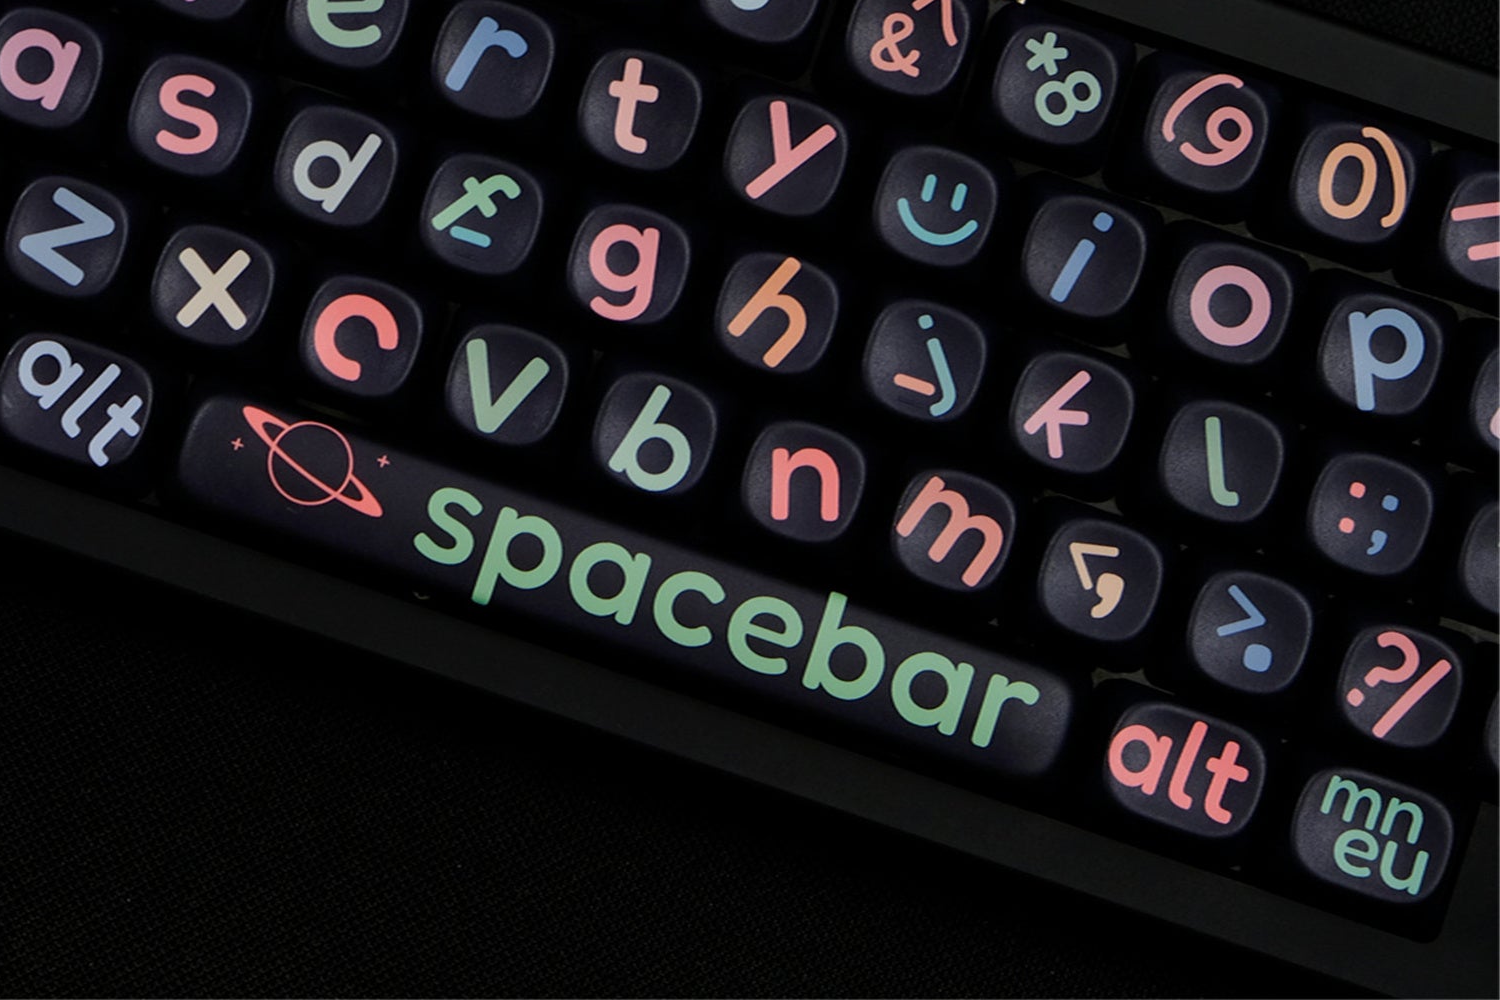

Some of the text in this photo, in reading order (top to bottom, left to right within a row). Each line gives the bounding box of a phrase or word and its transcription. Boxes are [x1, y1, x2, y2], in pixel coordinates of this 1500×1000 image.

[445, 17, 527, 91] r
[156, 75, 218, 155] s
[609, 58, 659, 154] t
[745, 101, 836, 199] y
[292, 134, 382, 213] d
[18, 187, 115, 286] z
[588, 224, 660, 321] g
[1050, 212, 1113, 302] i
[176, 248, 250, 330] x
[727, 257, 807, 368] h
[1190, 265, 1271, 346] o
[310, 294, 399, 381] c
[1349, 309, 1424, 411] p
[18, 341, 143, 466] alt
[467, 339, 549, 433] v
[1023, 371, 1091, 458] k
[608, 385, 691, 491] b
[771, 448, 840, 521] n
[1205, 417, 1239, 506] l
[896, 476, 1003, 587] m
[414, 482, 1040, 747] spacebar
[1108, 721, 1249, 824] alt
